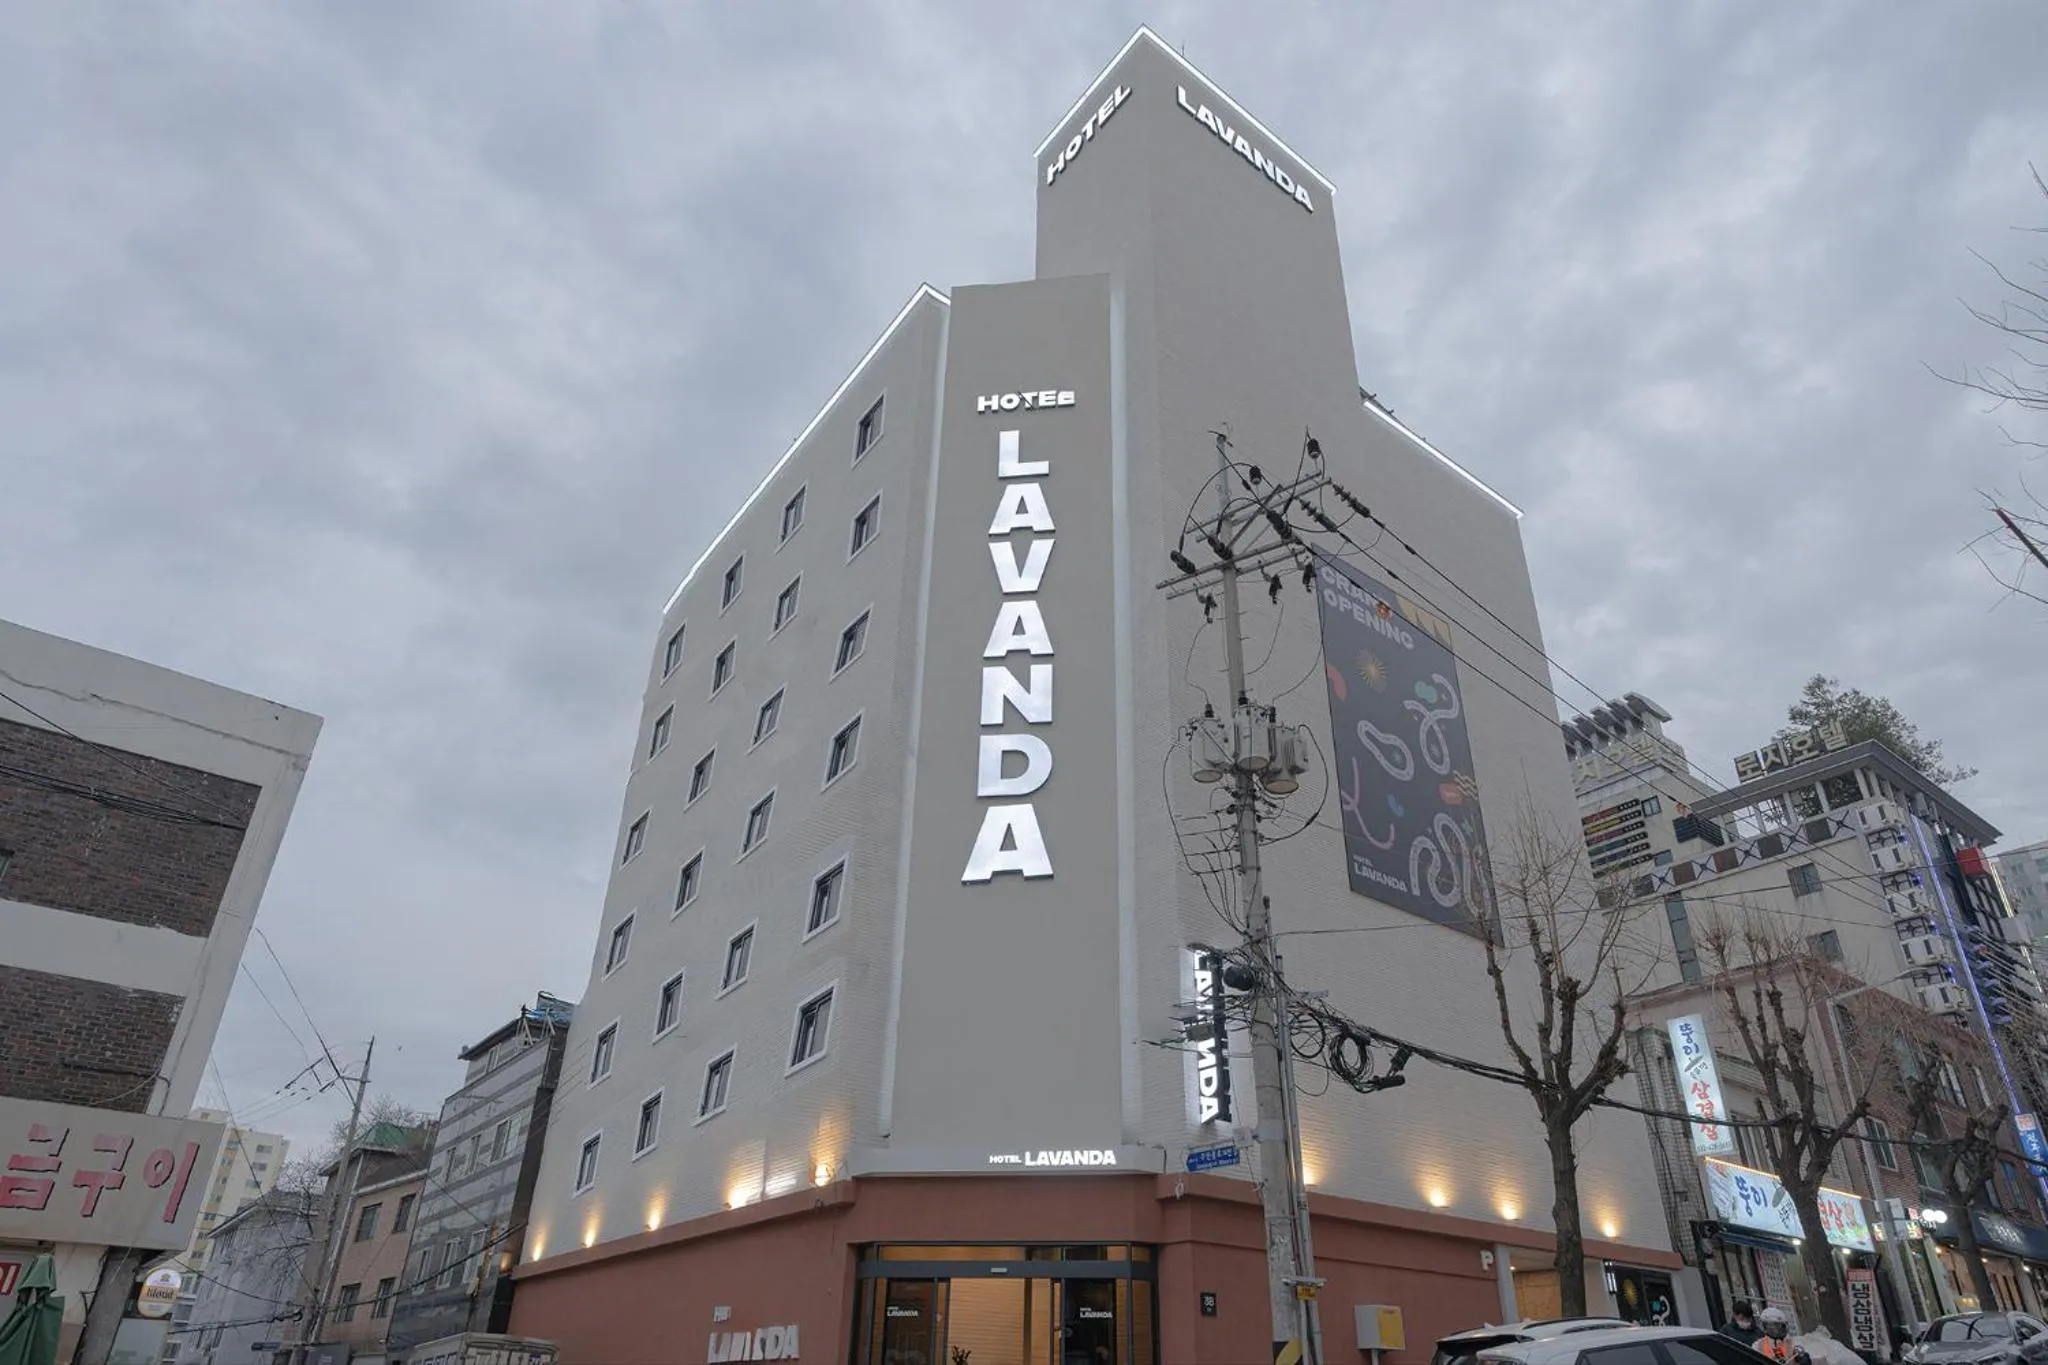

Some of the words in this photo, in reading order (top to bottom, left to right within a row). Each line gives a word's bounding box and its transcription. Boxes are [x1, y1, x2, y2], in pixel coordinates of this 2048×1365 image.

[1047, 84, 1132, 184] HOTEL
[1176, 85, 1315, 213] LAVANDA
[977, 390, 1077, 413] HOTEL
[1323, 587, 1415, 651] OPENING
[961, 429, 1057, 884] LAVANDA
[1735, 717, 1849, 781] 로지호텔
[989, 1155, 1022, 1164] HOTEL
[1025, 1150, 1117, 1167] LAVANDA
